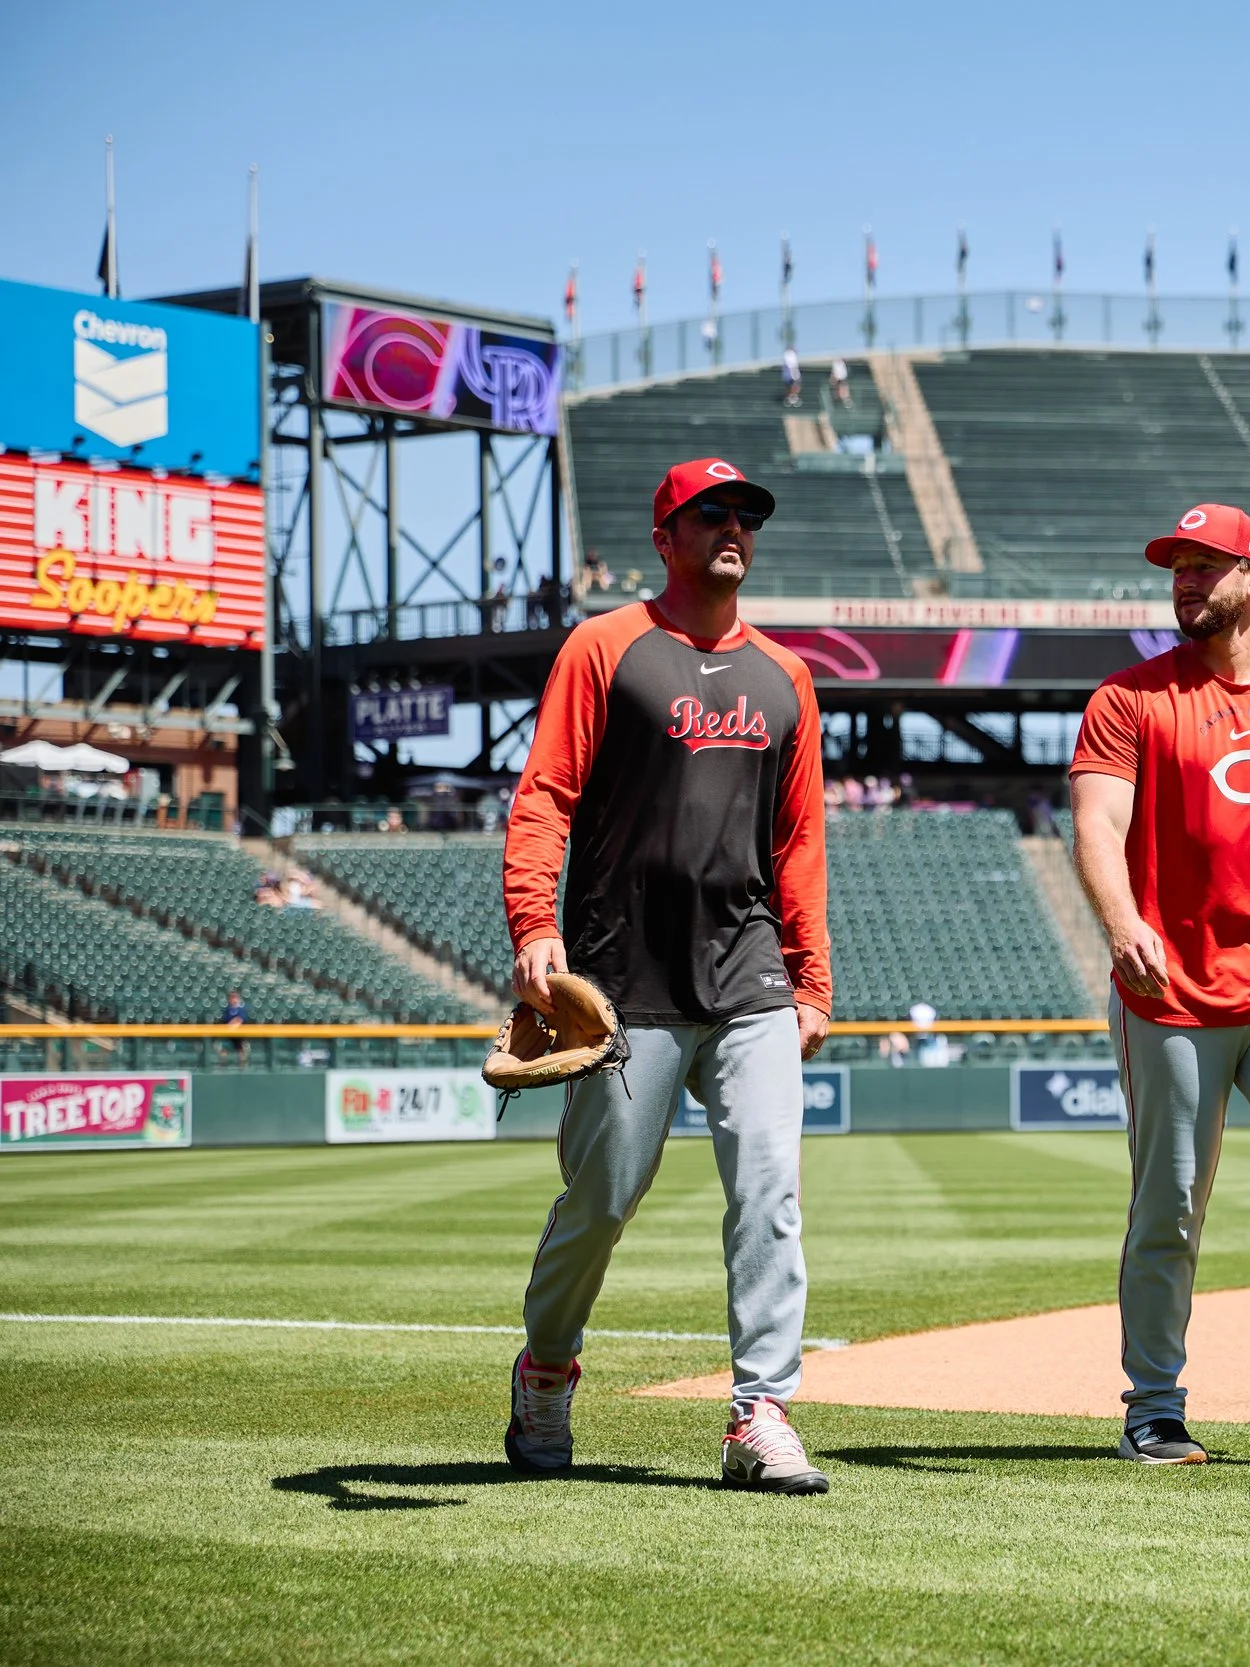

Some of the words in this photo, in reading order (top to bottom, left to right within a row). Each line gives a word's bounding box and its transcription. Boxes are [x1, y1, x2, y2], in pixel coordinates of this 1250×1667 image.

[74, 309, 167, 350] Chevron
[34, 478, 215, 566] KING
[30, 549, 216, 632] Soopers
[356, 694, 445, 725] PLATTE
[667, 695, 771, 755] Reds
[528, 1064, 561, 1076] Wilson
[3, 1096, 87, 1141] TREE
[85, 1083, 145, 1125] TOP
[1061, 1078, 1124, 1116] dial
